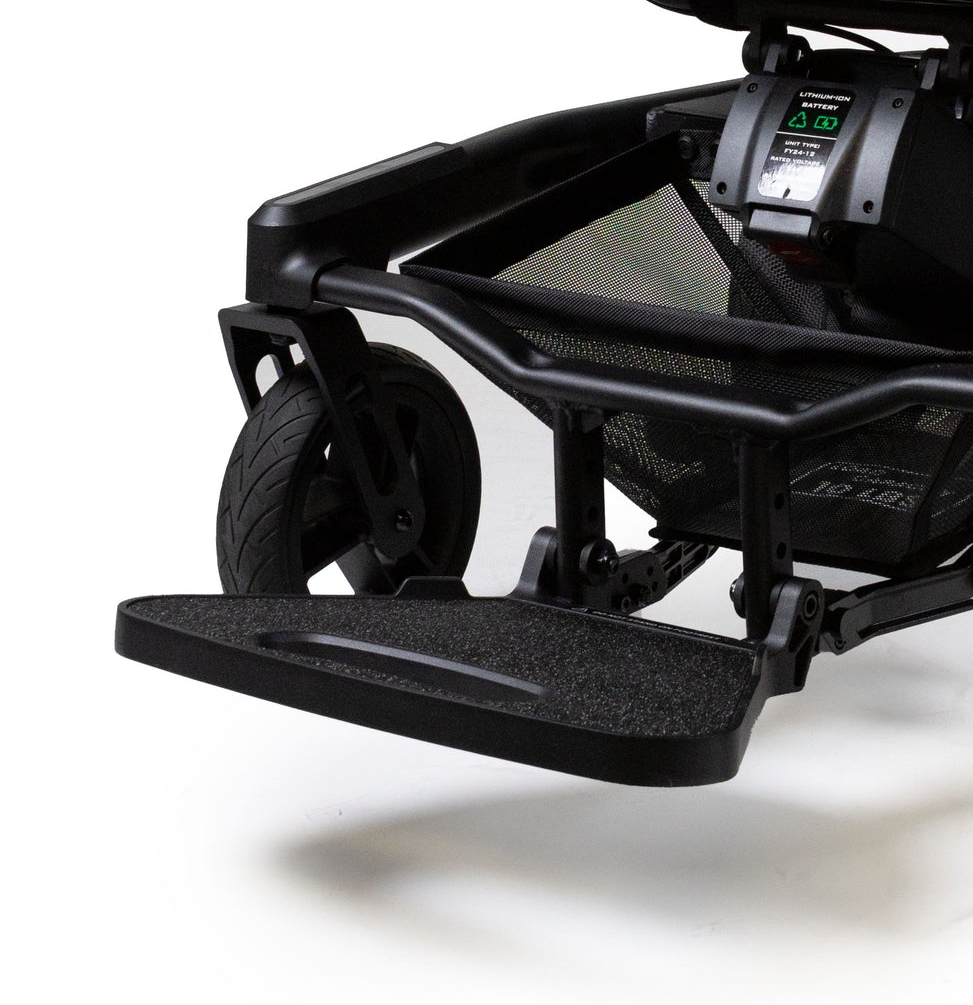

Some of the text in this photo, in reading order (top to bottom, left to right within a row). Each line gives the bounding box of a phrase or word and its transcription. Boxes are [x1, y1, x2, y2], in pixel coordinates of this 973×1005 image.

[799, 91, 851, 102] LITHIUM-ION
[801, 102, 839, 111] BATTERY
[784, 148, 816, 157] FY24-12
[770, 155, 791, 163] RATED
